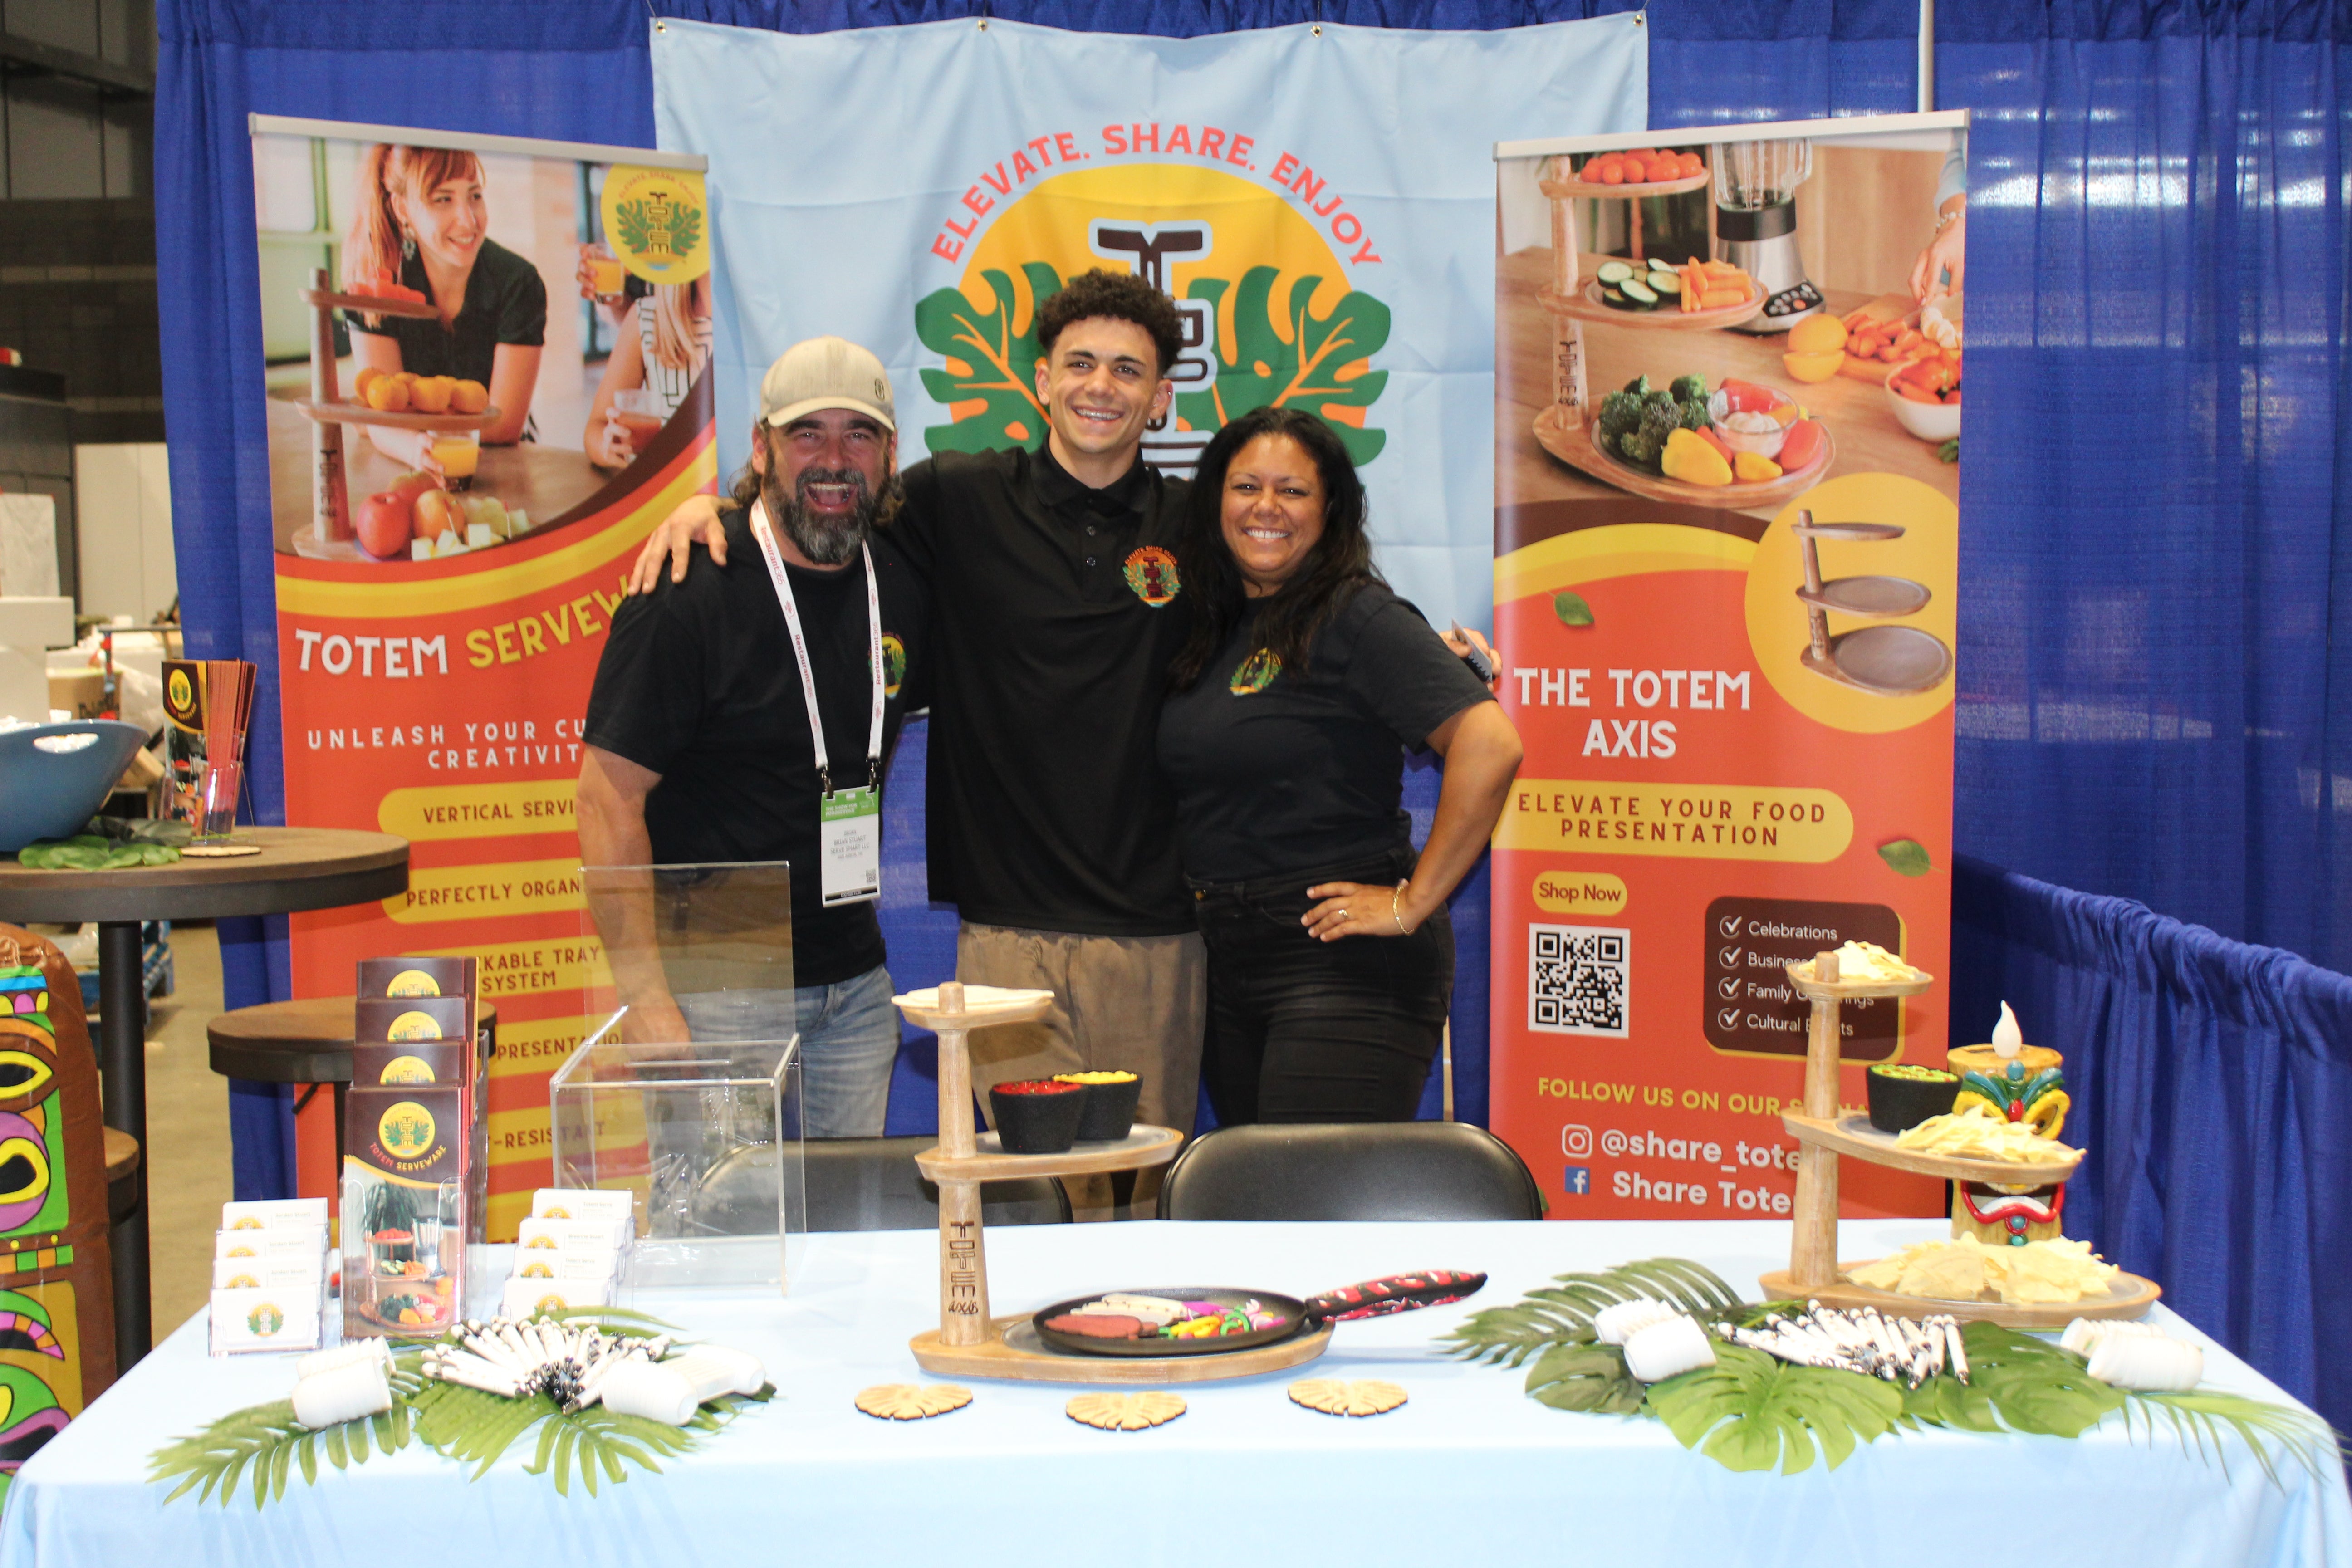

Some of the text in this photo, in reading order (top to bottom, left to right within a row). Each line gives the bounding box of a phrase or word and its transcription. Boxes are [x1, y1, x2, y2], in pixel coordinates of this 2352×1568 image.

[931, 123, 1382, 268] ELEVATE. SHARE. ENJOY
[295, 574, 629, 678] TOTEM SERVEW
[872, 622, 881, 685] Restaurant365
[1513, 666, 1751, 711] THE TOTEM
[308, 724, 445, 750] UNLEASH
[465, 721, 536, 742] YOUR
[1581, 719, 1678, 759] AXIS
[427, 743, 580, 769] CREATIVIT
[423, 799, 574, 823] VERTICAL SERVI
[1519, 793, 1826, 823] ELEVATE YOUR FOOD
[1561, 819, 1779, 846] PRESENTATION
[407, 878, 580, 907] PERFECTLY ORGAN
[1539, 881, 1621, 903] Shop Now
[1748, 920, 1838, 941] Celebrations
[553, 946, 599, 965] TRAY
[482, 970, 556, 992] SYSTEM
[1747, 982, 1792, 1004] Family
[1746, 1013, 1801, 1032] Cultural
[1539, 1077, 1636, 1103] FOLLOW
[1643, 1086, 1674, 1107] US
[1681, 1089, 1720, 1112] ON
[1728, 1093, 1781, 1117] OUR
[369, 1142, 448, 1172] TOTEM SERVEWARE
[1601, 1128, 1800, 1173] @share_tote
[1612, 1171, 1795, 1215] Share Tote
[949, 1220, 975, 1297] TOTEM
[948, 1300, 979, 1315] axis
